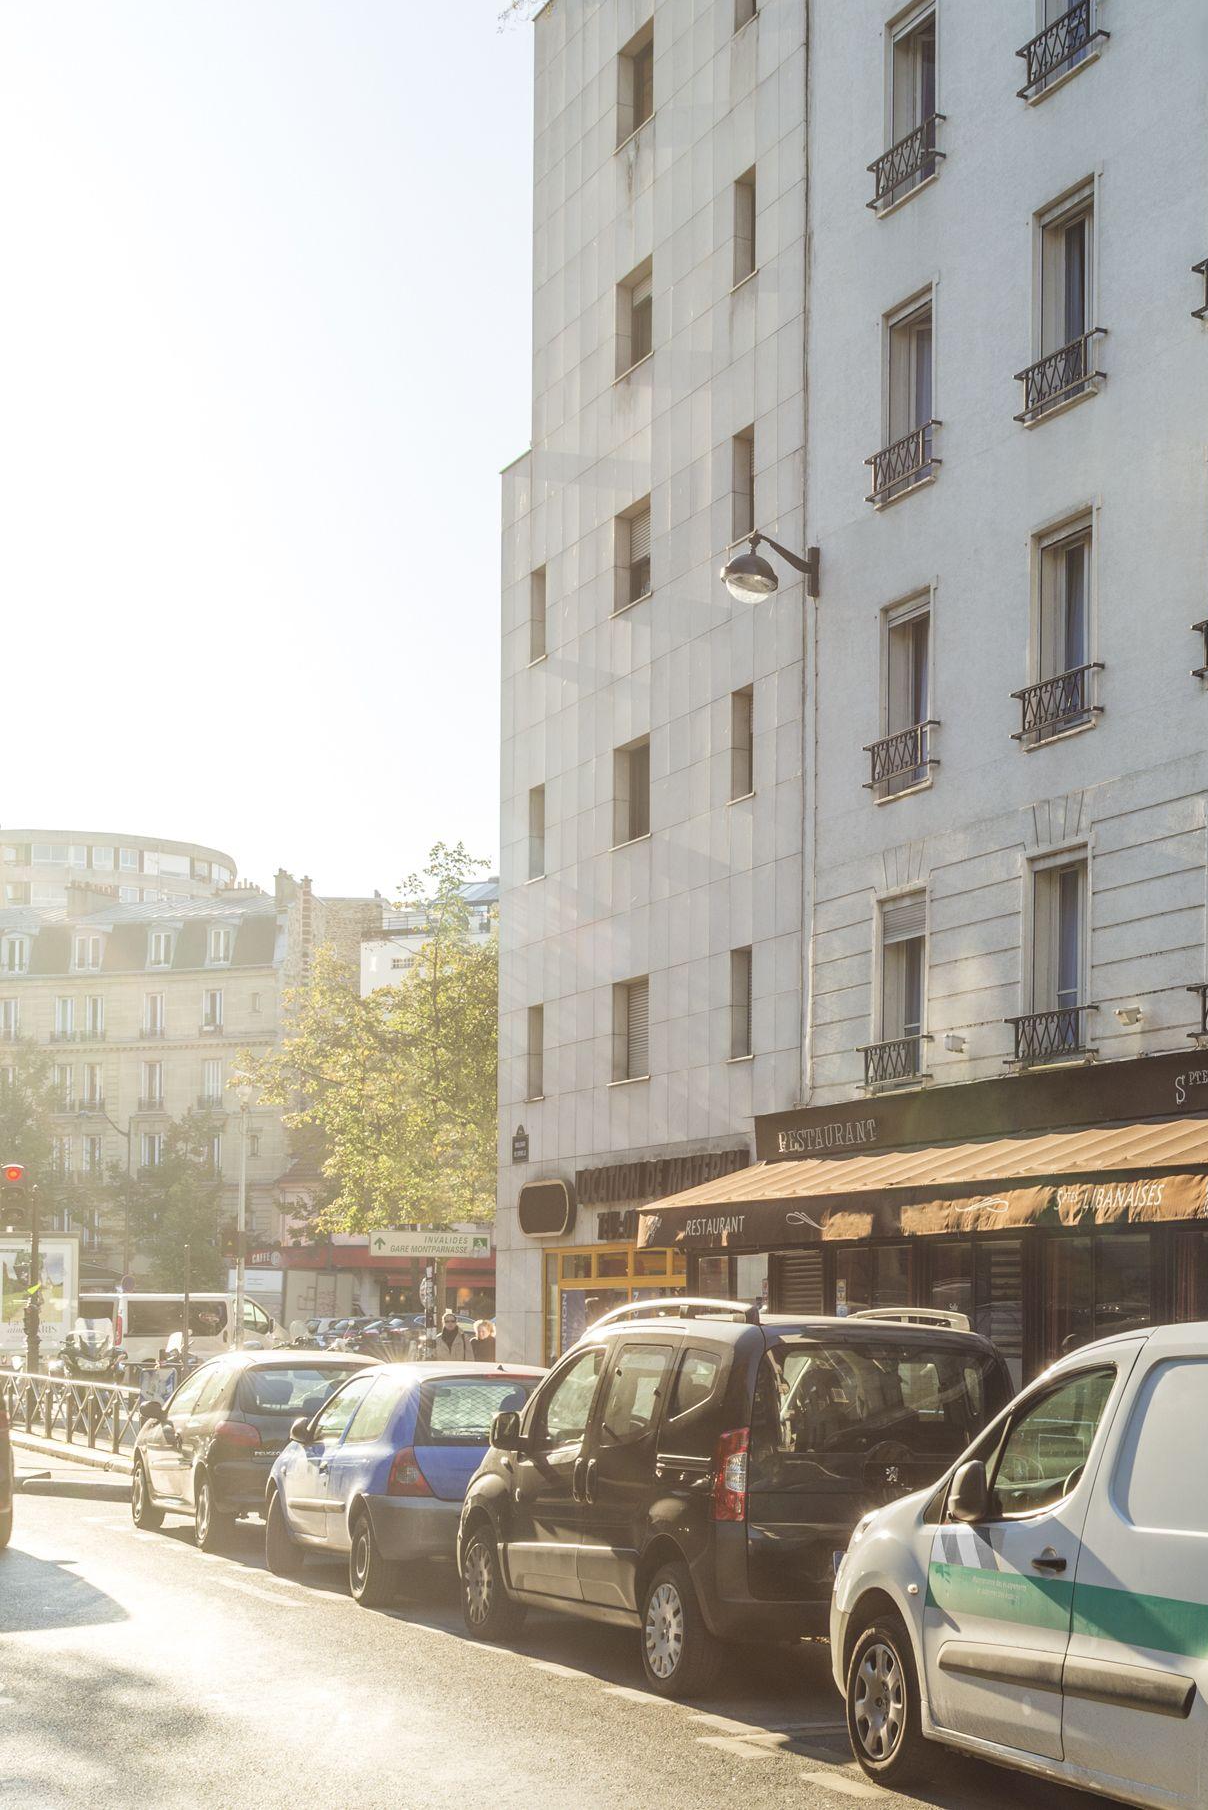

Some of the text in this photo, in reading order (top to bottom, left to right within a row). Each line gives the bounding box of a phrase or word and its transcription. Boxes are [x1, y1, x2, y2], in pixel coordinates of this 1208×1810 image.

[778, 1118, 877, 1152] RESTAURANT
[1081, 1184, 1166, 1211] LIBANAISES
[685, 1215, 745, 1236] RESTAURANT
[391, 1245, 468, 1254] GARE MONTPARNASSE
[424, 1235, 469, 1245] INVALIDES
